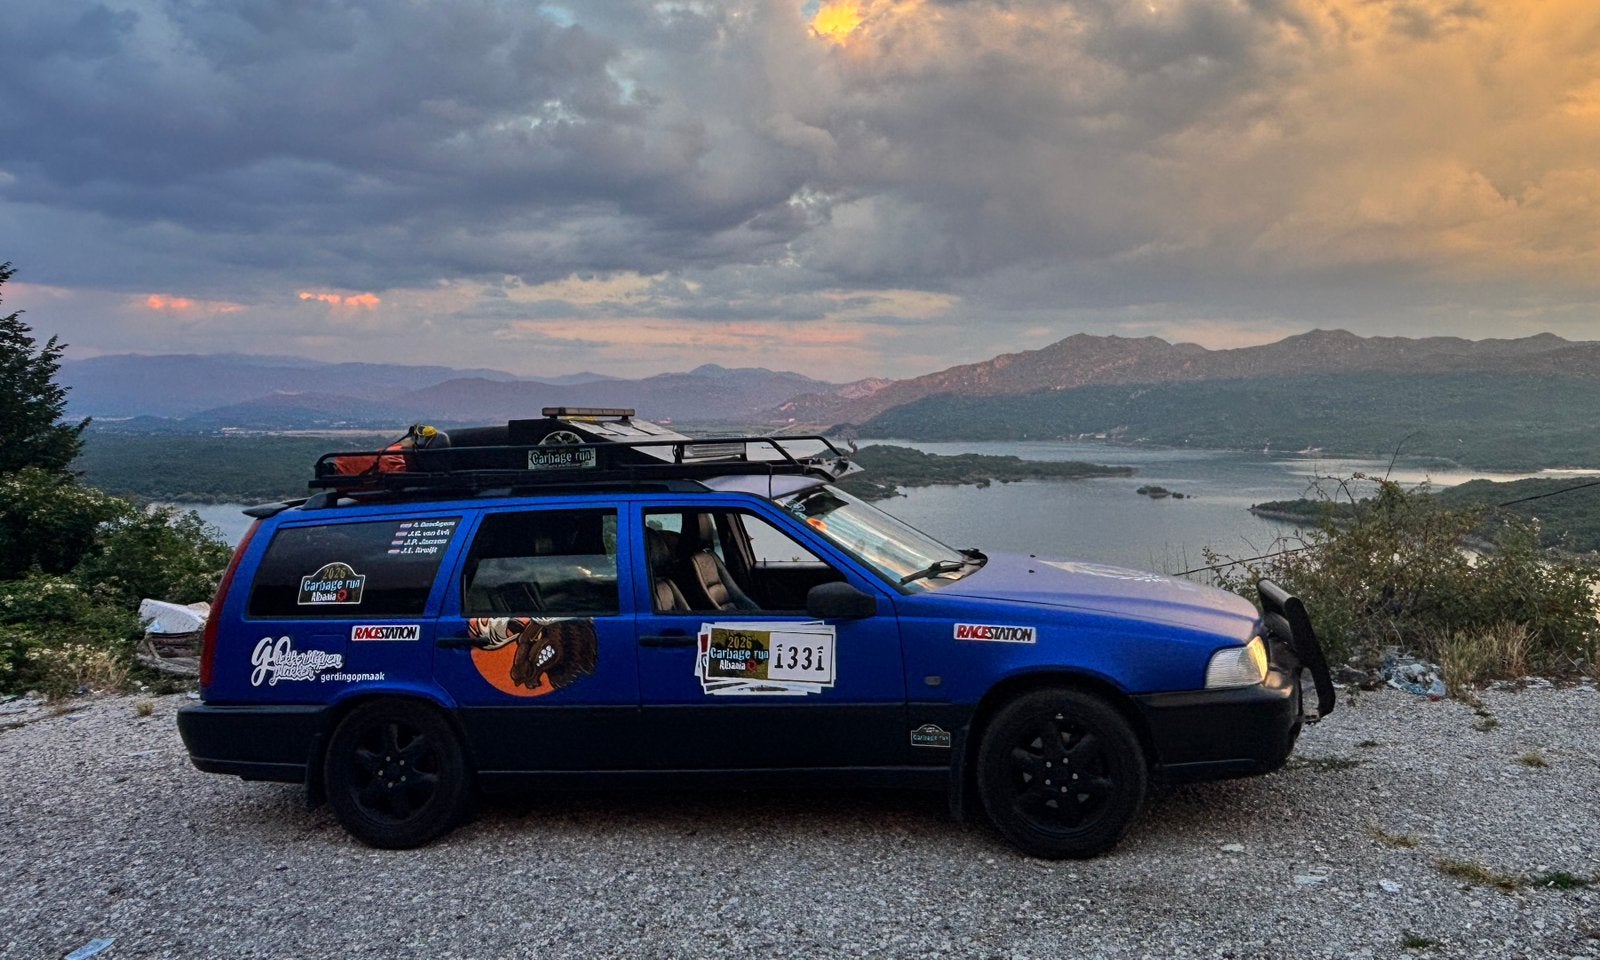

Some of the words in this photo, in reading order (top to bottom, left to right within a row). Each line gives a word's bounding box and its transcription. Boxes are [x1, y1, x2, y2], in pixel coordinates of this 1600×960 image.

[322, 567, 346, 579] 2026
[304, 579, 344, 592] Carbage
[346, 579, 361, 588] run
[311, 591, 337, 602] Albania
[354, 626, 417, 640] RACESTATION
[957, 625, 1032, 641] RACESTATION
[728, 636, 753, 648] 2026
[710, 647, 751, 660] Carbage
[753, 649, 769, 659] run
[774, 644, 825, 671] 1331
[720, 659, 746, 671] Albania
[320, 672, 385, 683] gerdingopmaak
